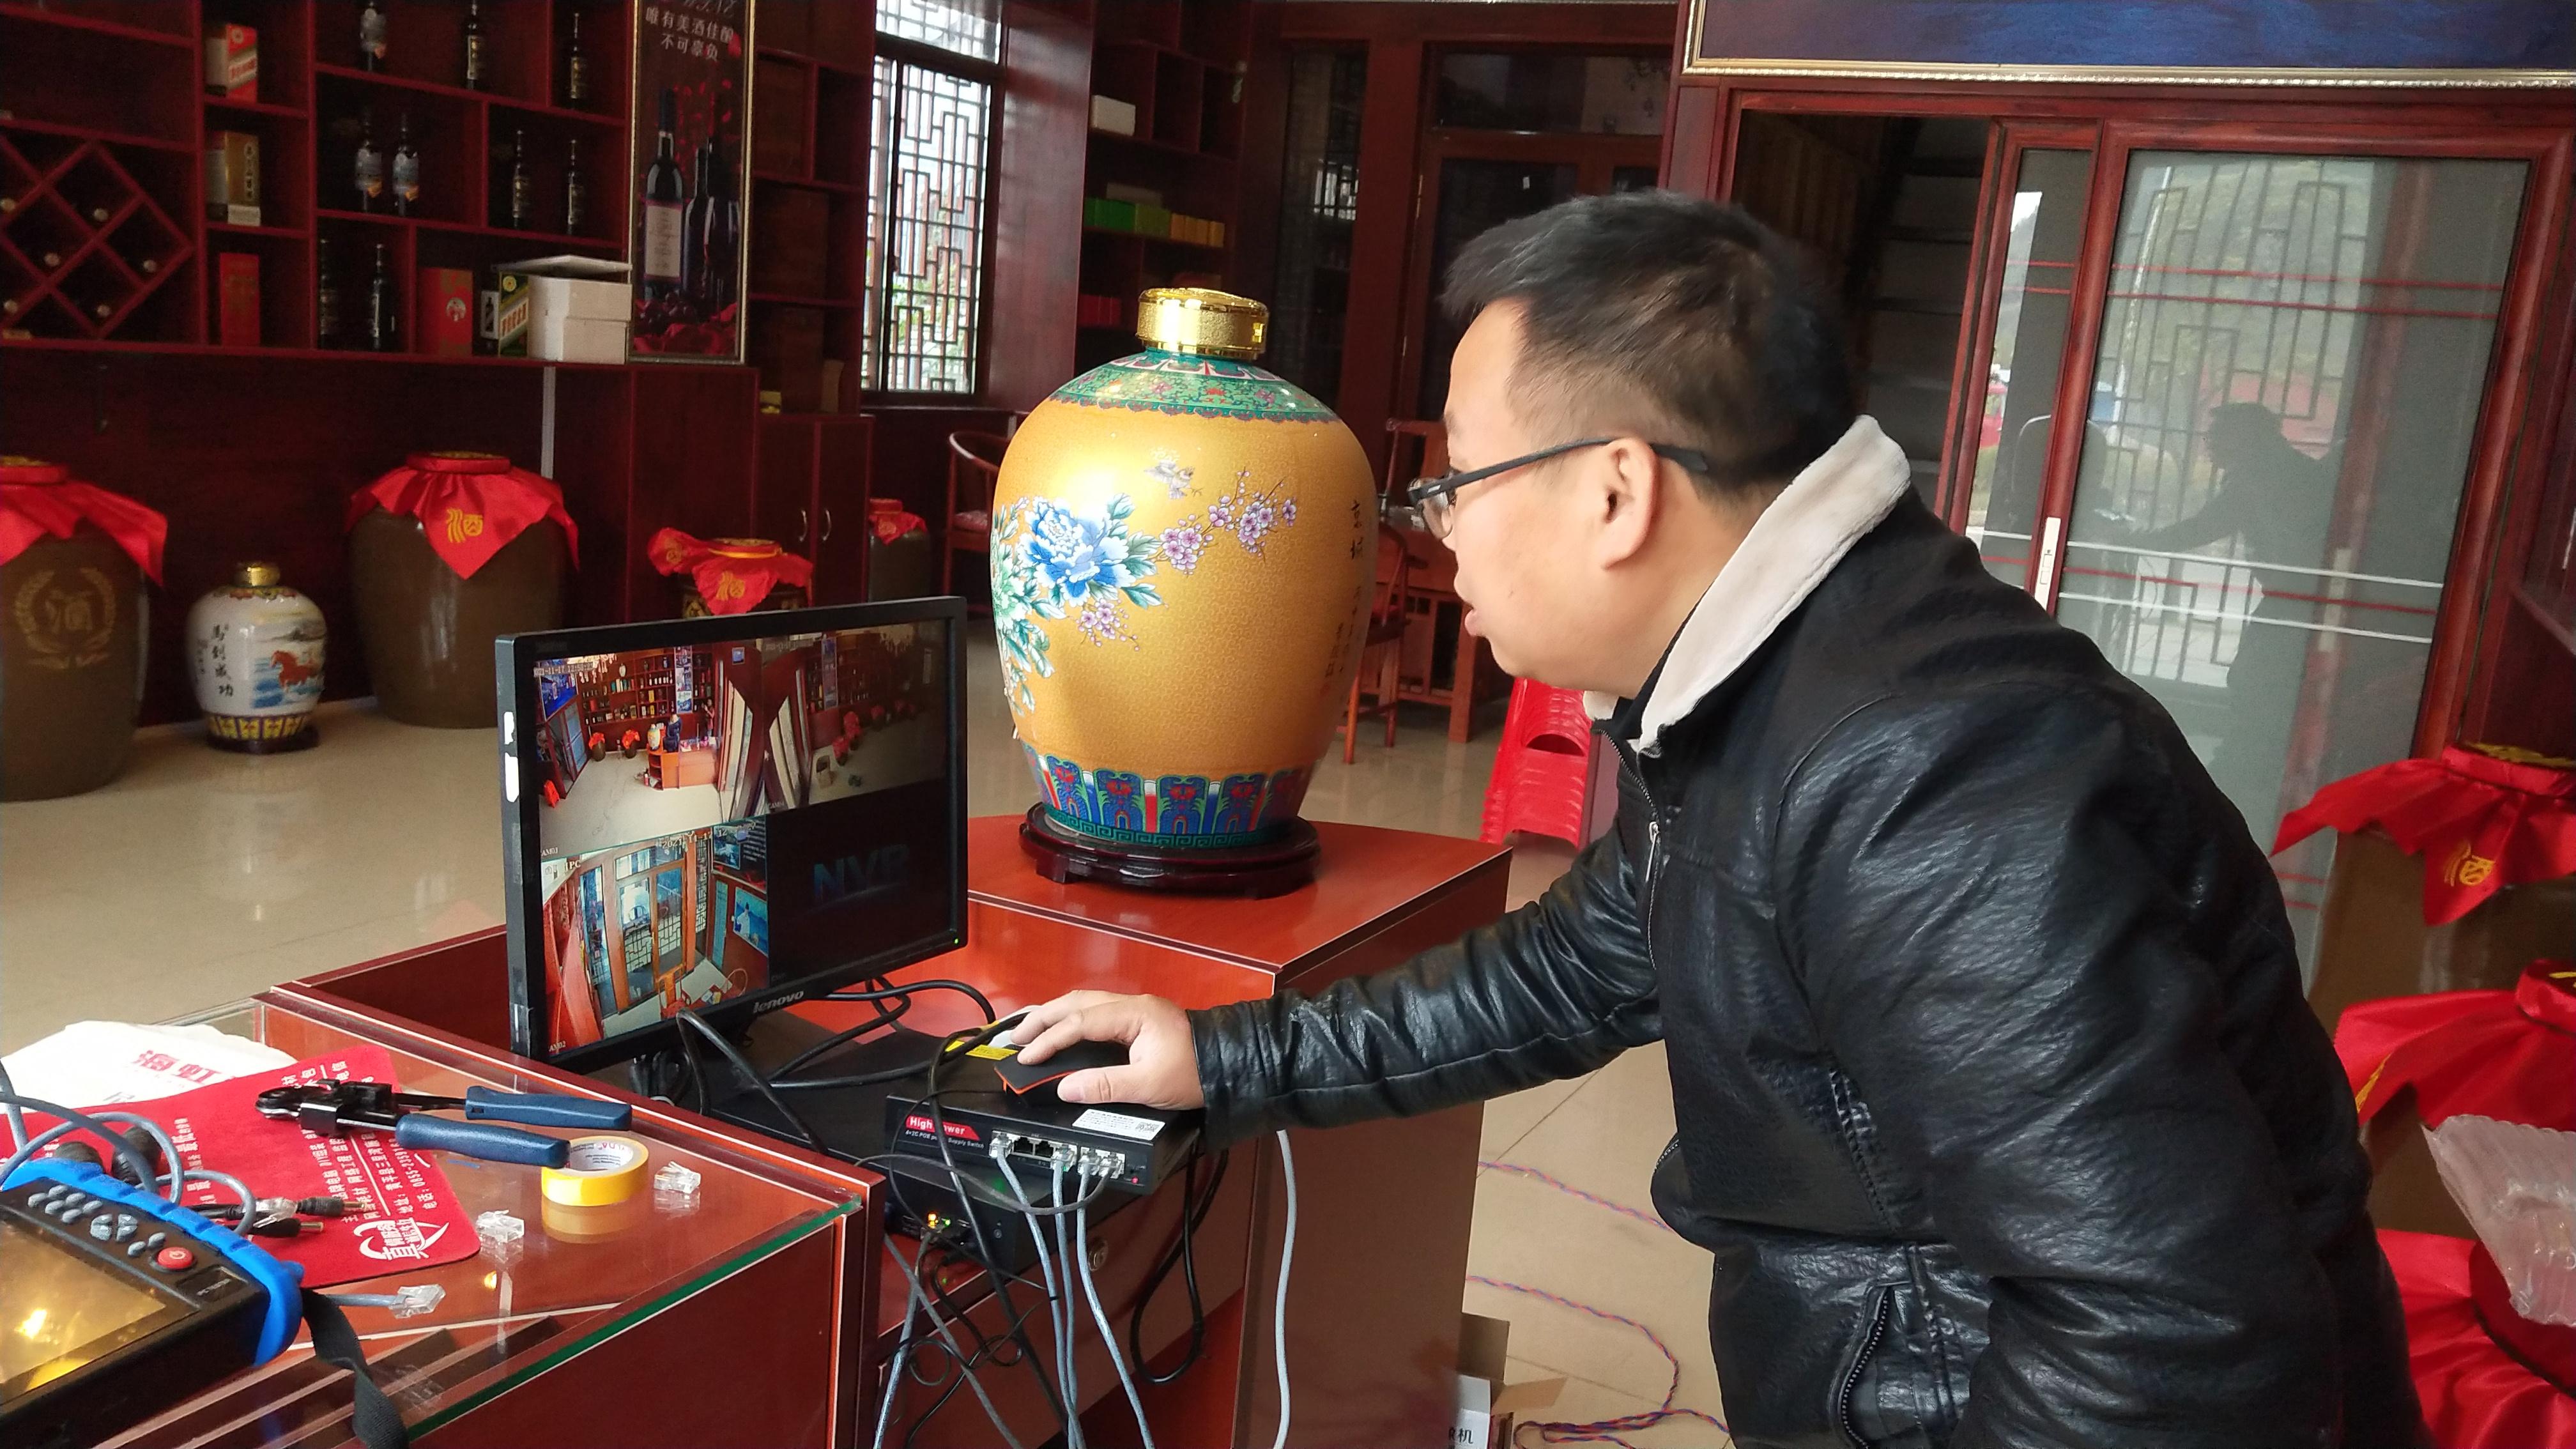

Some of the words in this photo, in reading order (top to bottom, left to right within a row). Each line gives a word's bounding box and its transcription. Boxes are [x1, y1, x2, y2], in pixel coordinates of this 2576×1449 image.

[645, 6, 734, 43] 唯有美酒佳酿
[753, 990, 804, 1014] lenovo
[549, 1040, 566, 1052] AM02
